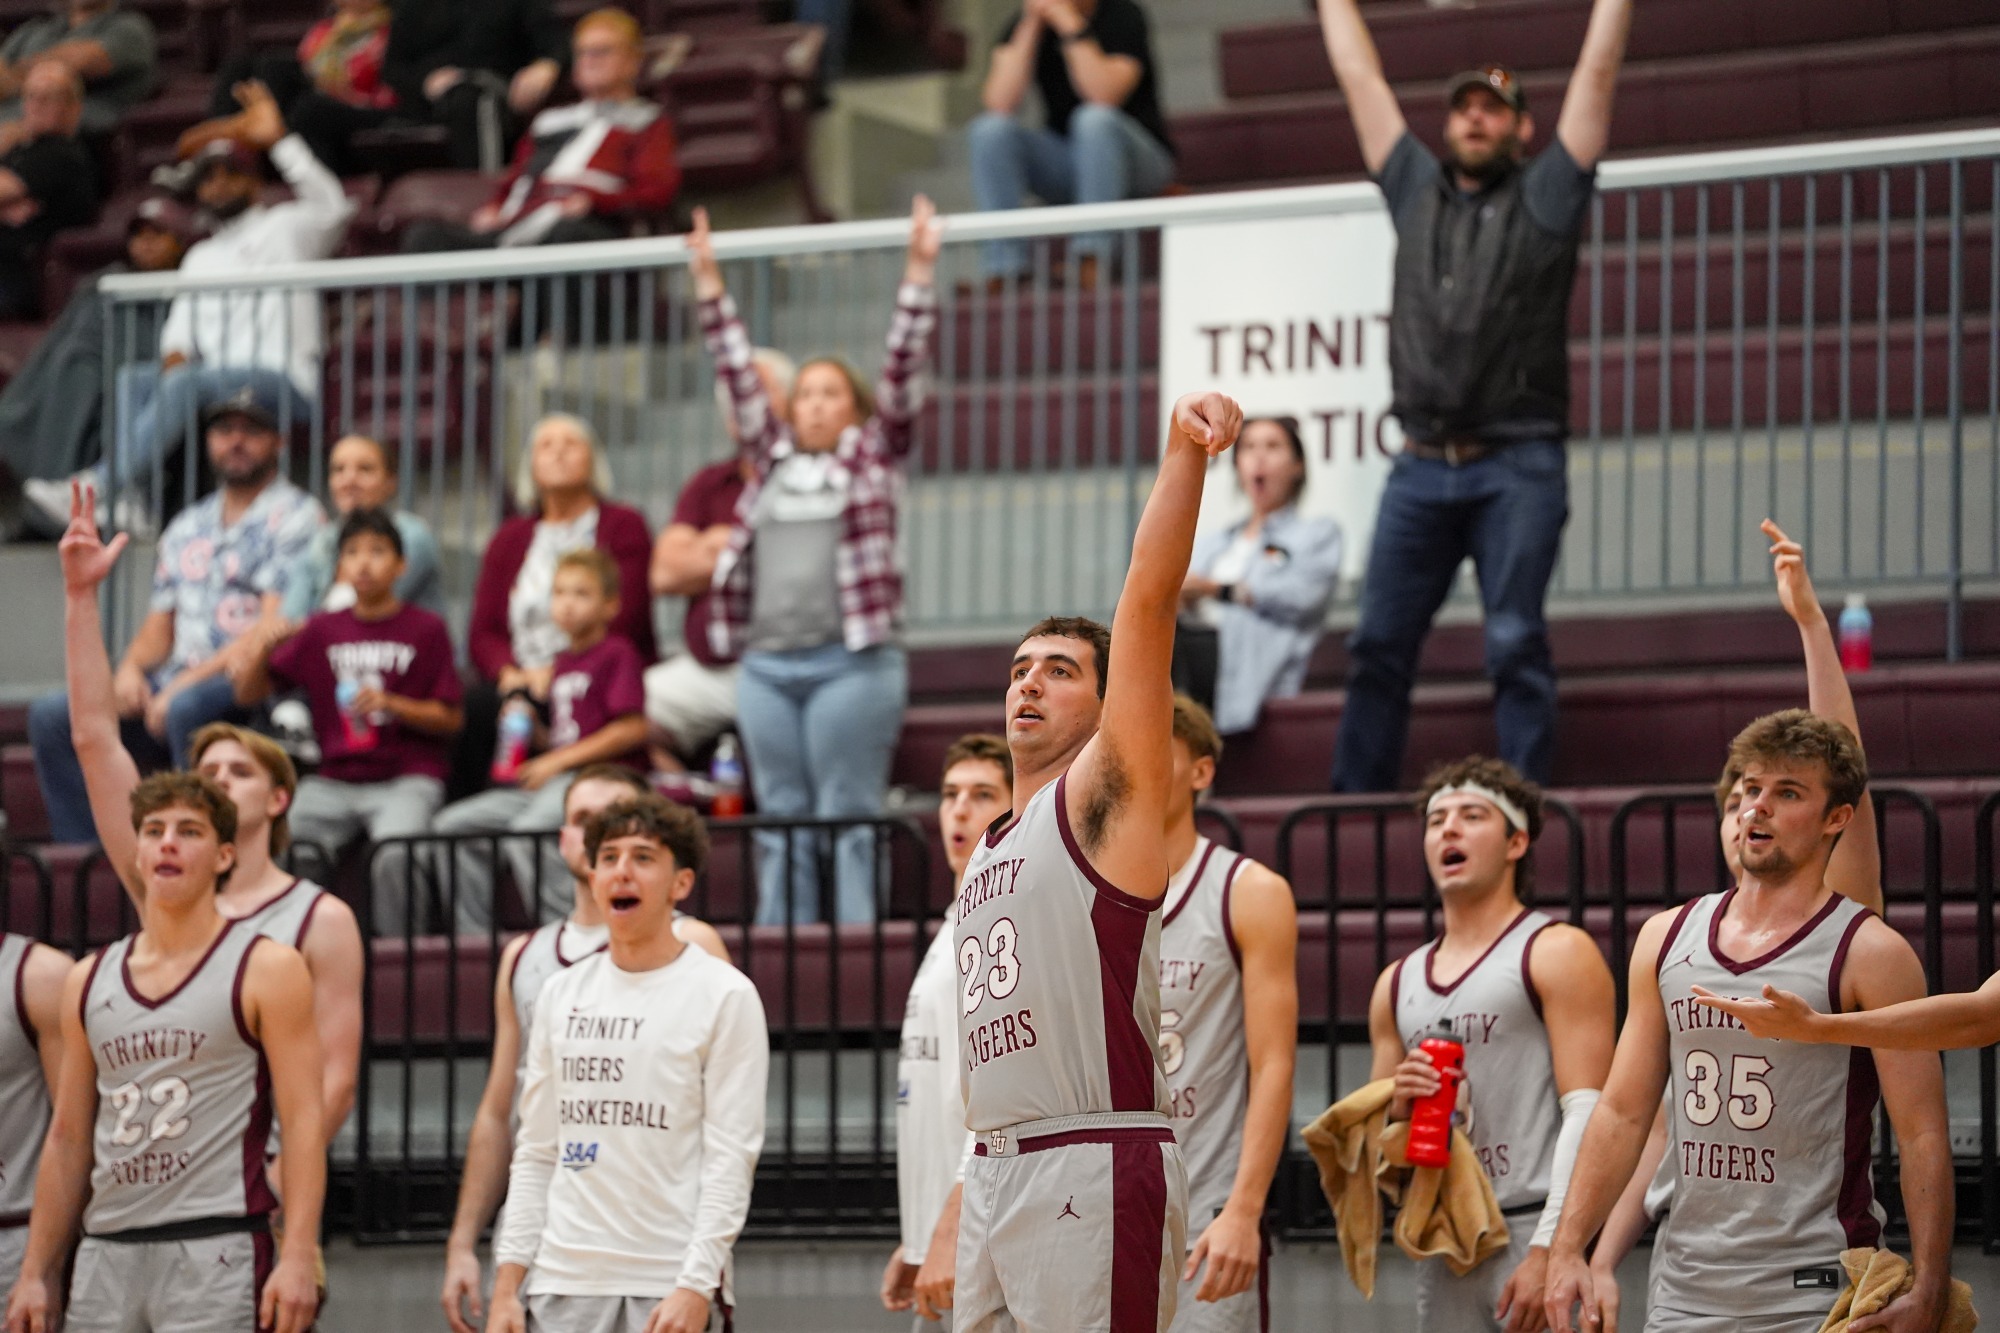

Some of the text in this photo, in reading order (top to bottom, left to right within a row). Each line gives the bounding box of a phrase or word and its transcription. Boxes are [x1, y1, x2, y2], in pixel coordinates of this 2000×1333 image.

[955, 857, 1025, 928] TRINITY
[959, 917, 1021, 1019] 23
[101, 1028, 206, 1072] TRINITY
[566, 1016, 644, 1040] TRINITY
[562, 1056, 624, 1082] TIGERS
[1684, 1049, 1777, 1131] 35
[111, 1075, 192, 1147] 22
[560, 1099, 670, 1131] BASKETBALL
[1682, 1140, 1776, 1184] TIGERS
